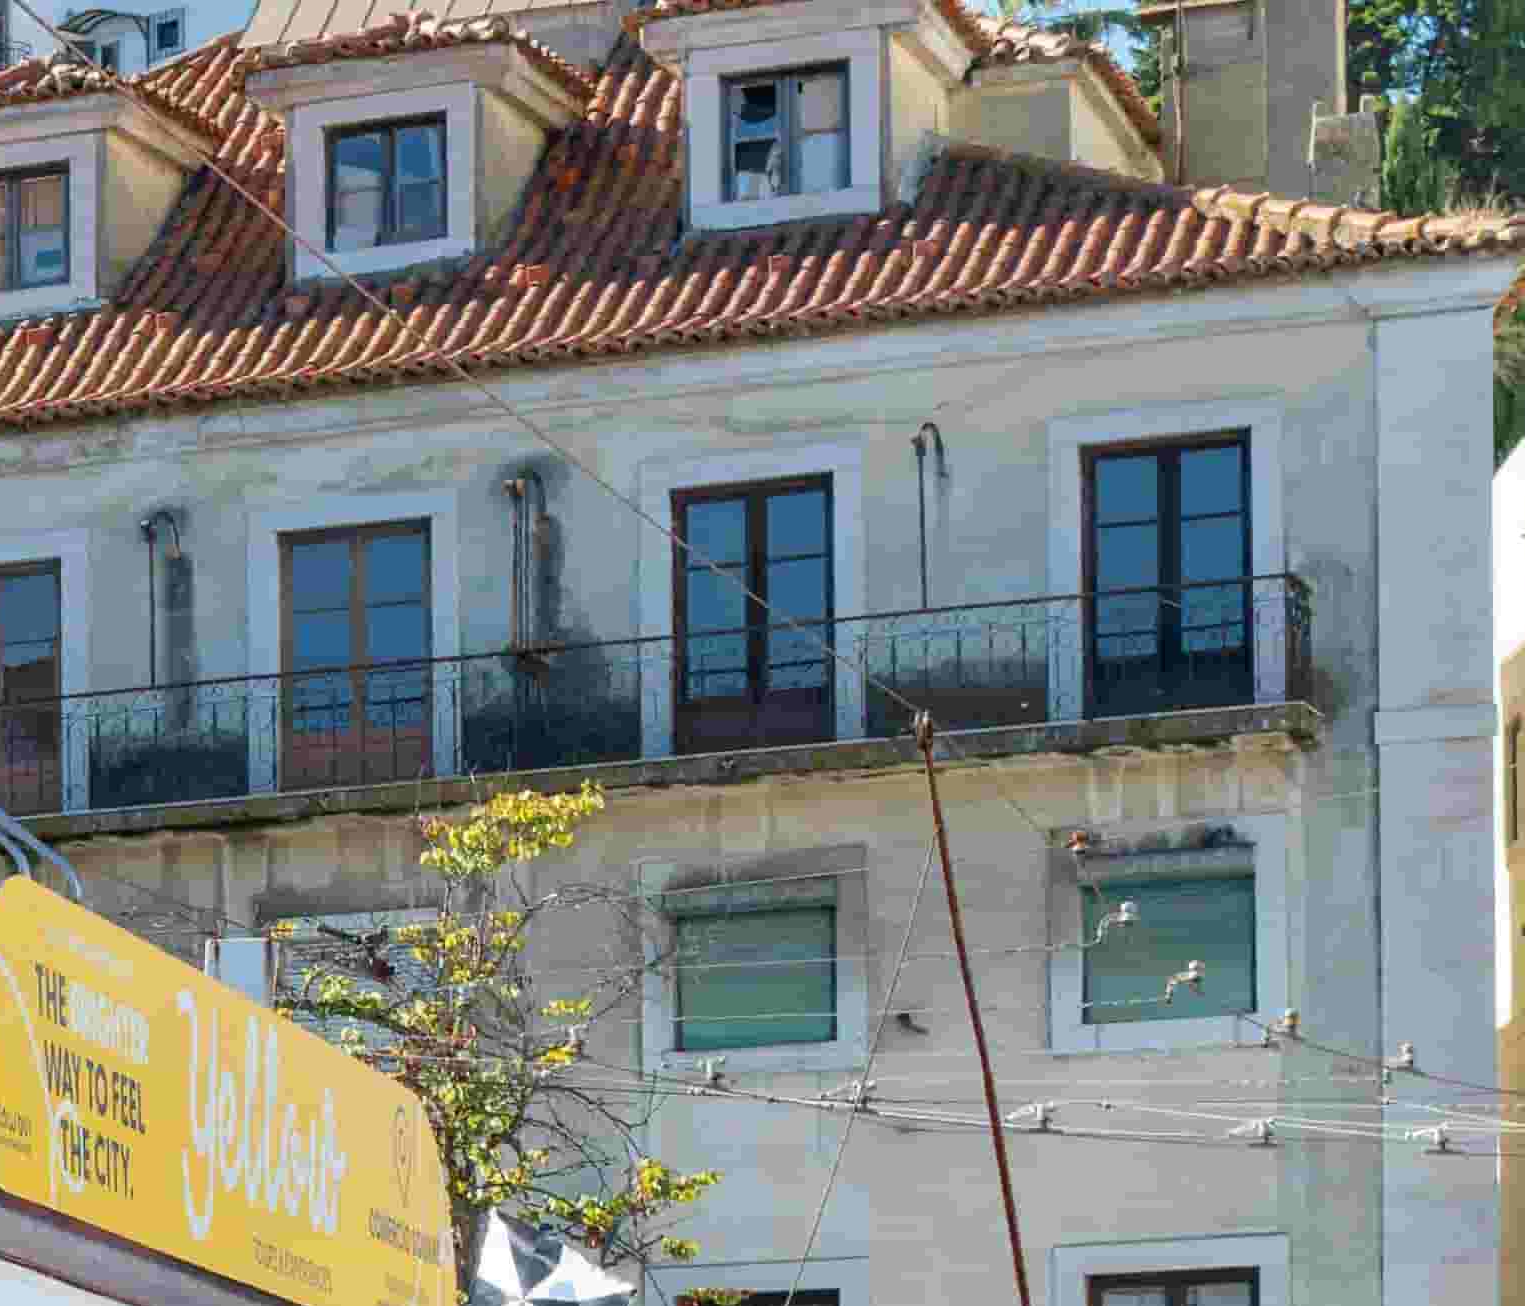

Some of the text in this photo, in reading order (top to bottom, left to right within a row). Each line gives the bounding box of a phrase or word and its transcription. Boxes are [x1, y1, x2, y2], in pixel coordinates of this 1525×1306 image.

[32, 960, 68, 1027] THE
[43, 1038, 81, 1106] WAY
[85, 1056, 109, 1117] TO
[111, 1070, 146, 1135] FEEL
[176, 989, 348, 1241] Yellow
[60, 1117, 91, 1185] THE
[93, 1130, 134, 1200] CITY.
